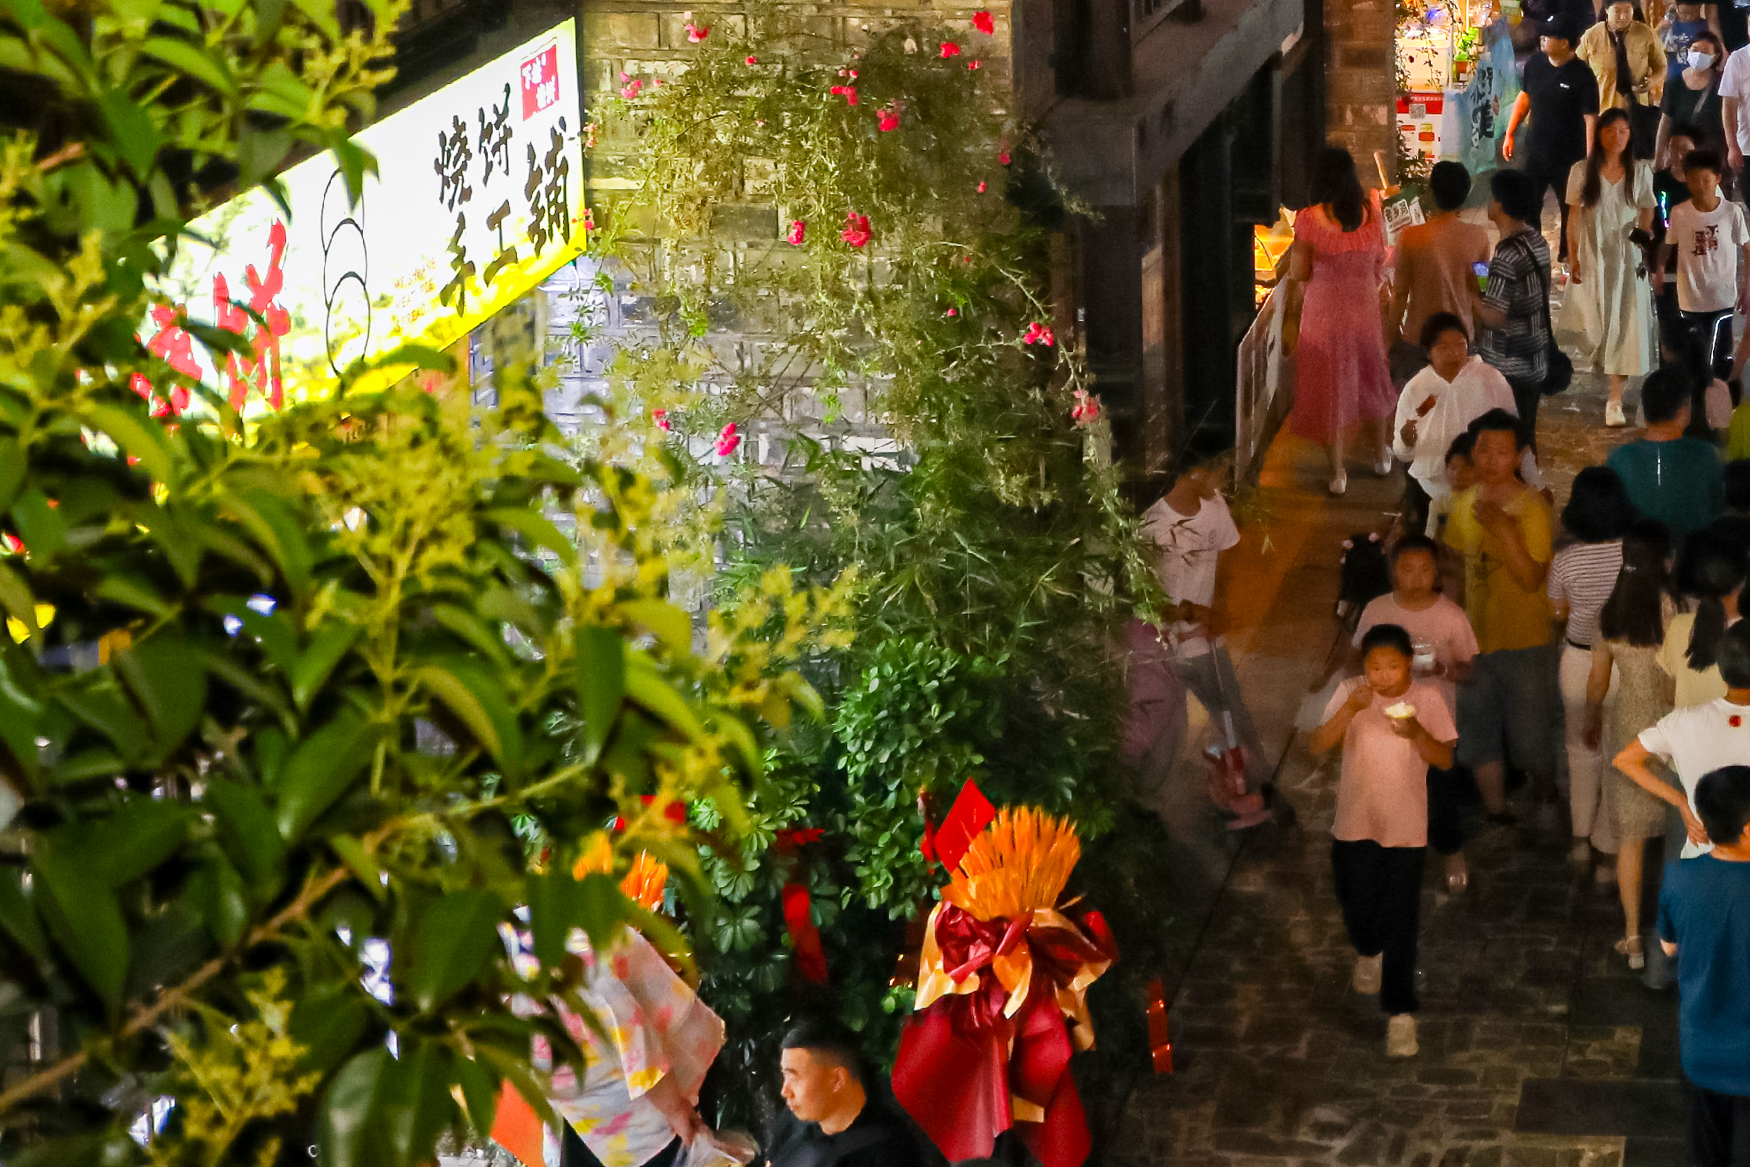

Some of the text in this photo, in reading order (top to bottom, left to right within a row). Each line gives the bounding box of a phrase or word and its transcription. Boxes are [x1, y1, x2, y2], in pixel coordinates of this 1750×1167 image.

[434, 82, 513, 213] 烧饼
[440, 116, 570, 318] 手工铺
